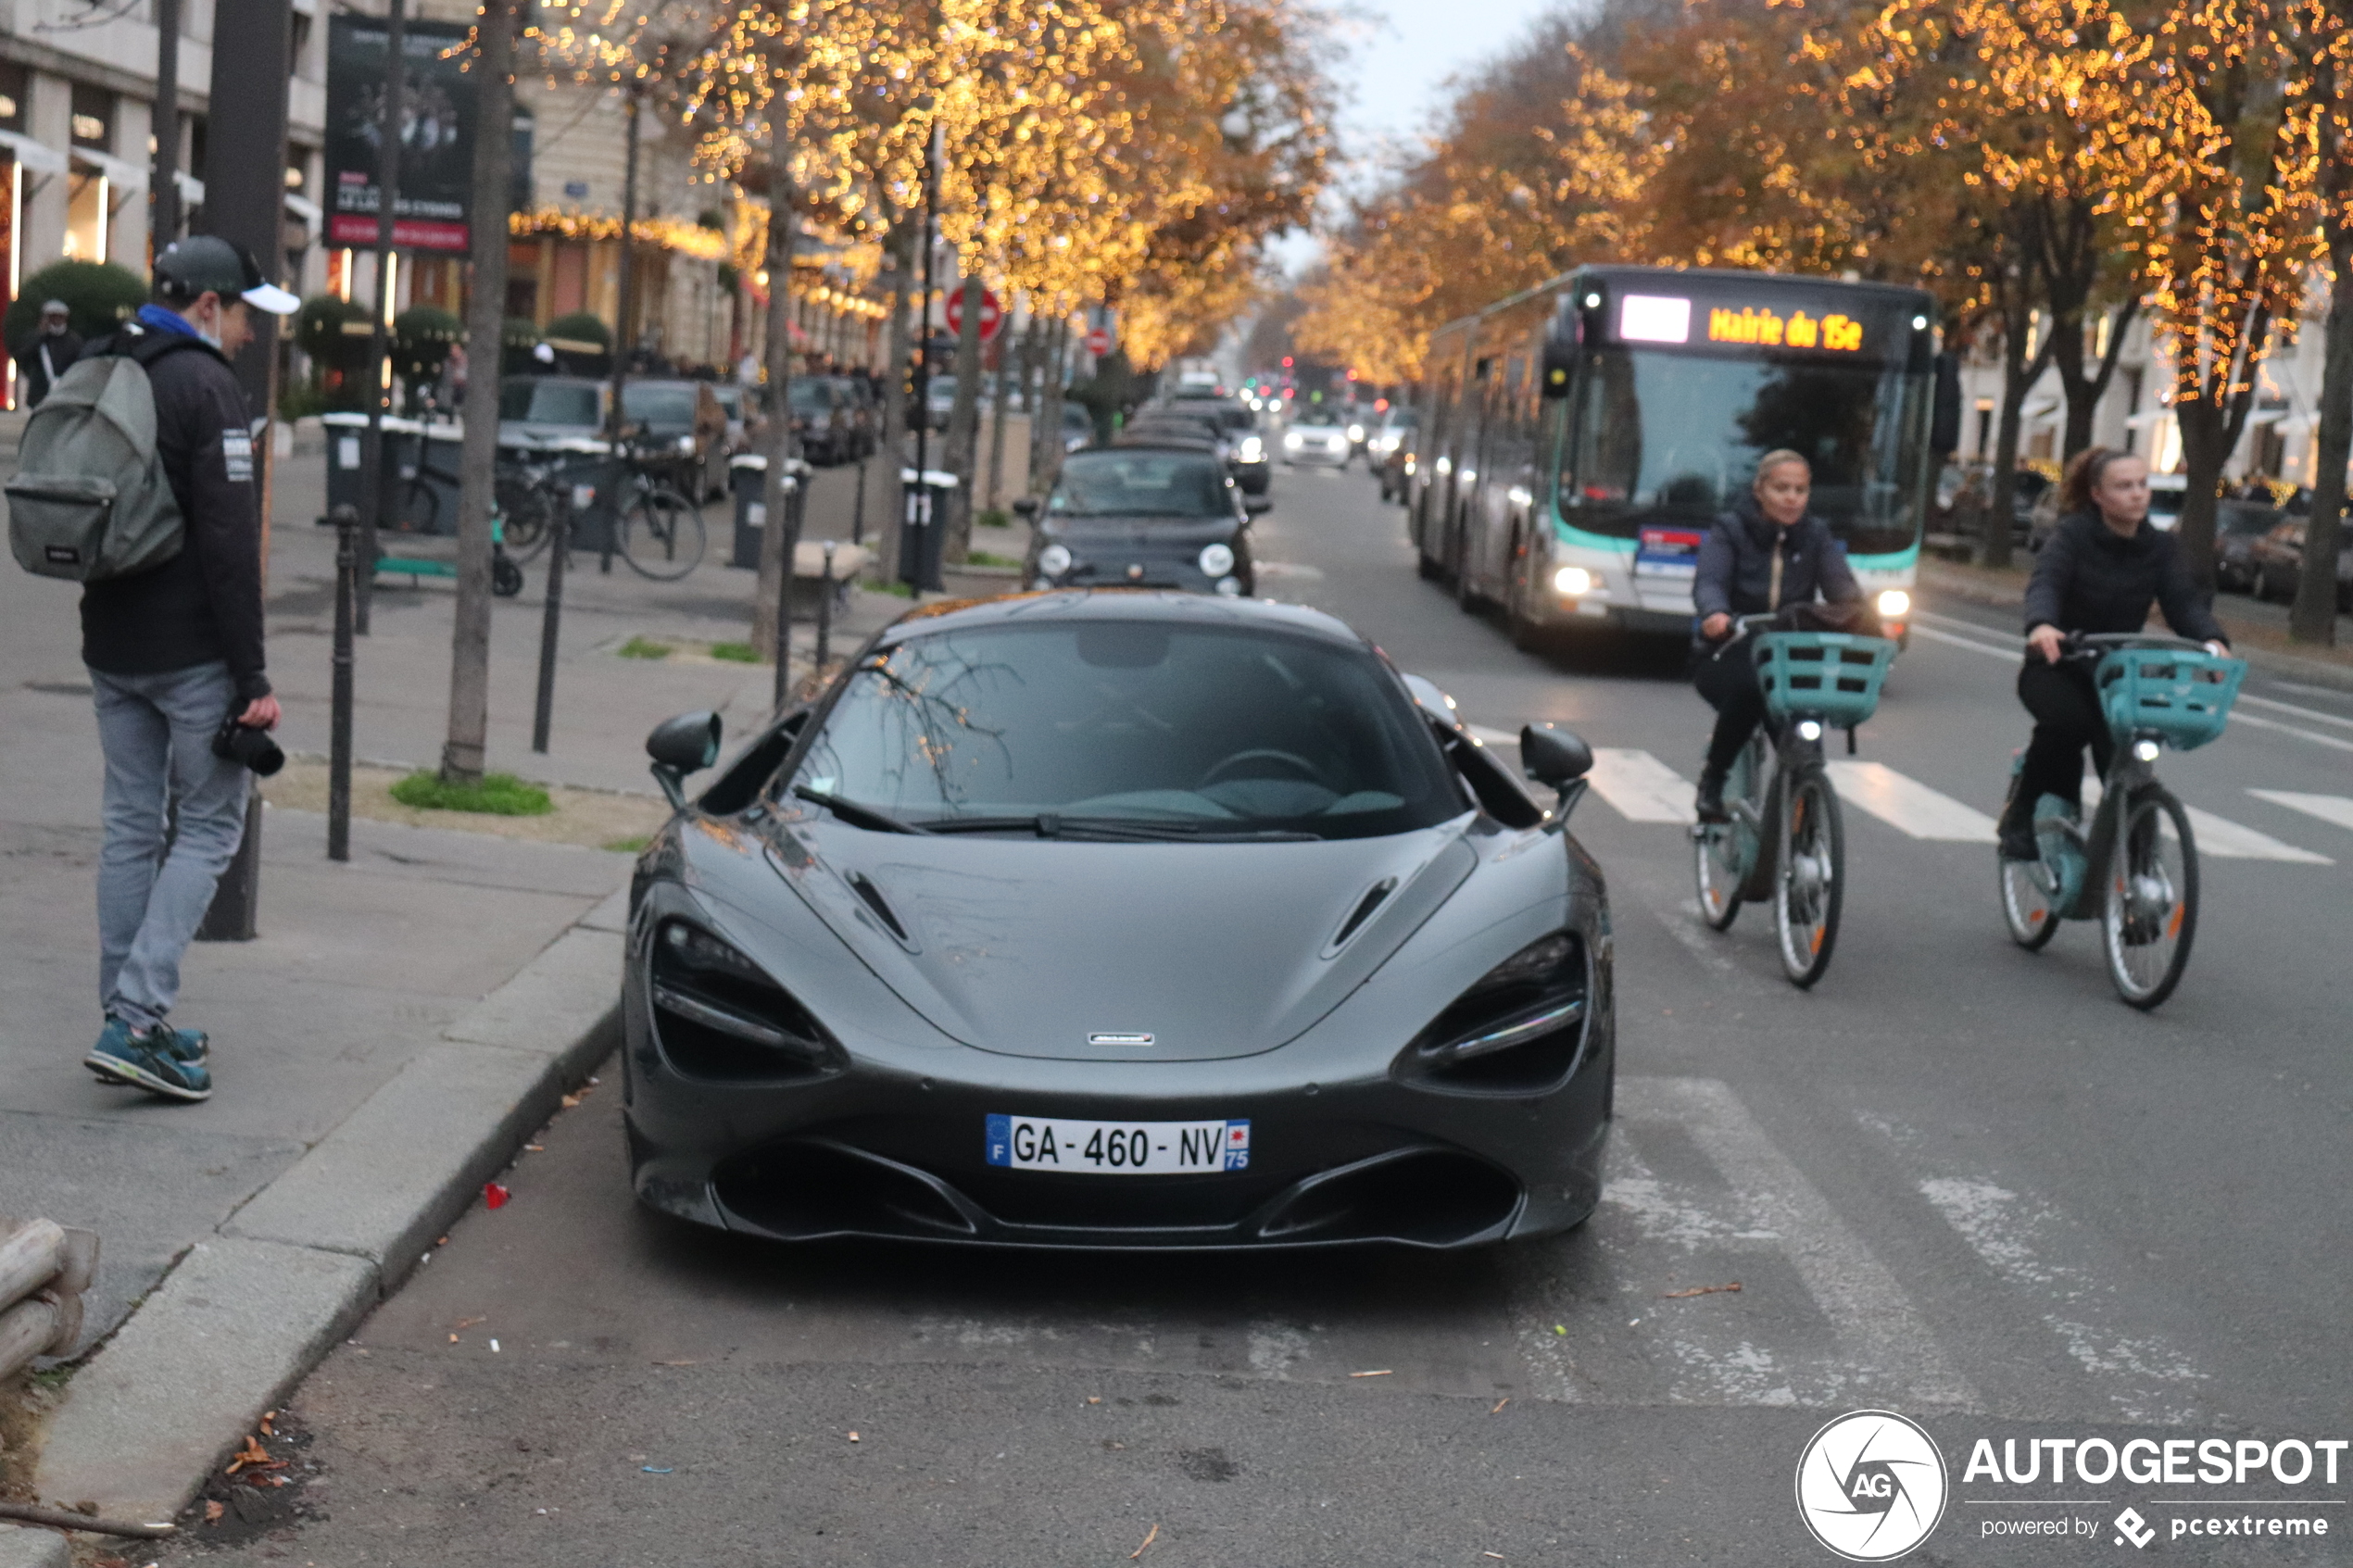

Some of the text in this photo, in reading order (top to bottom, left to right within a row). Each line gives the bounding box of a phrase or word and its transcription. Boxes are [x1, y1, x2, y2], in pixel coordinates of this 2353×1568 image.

[1708, 307, 1862, 351] Mairie du 15e
[992, 1145, 1004, 1160] F
[1226, 1150, 1249, 1168] 75
